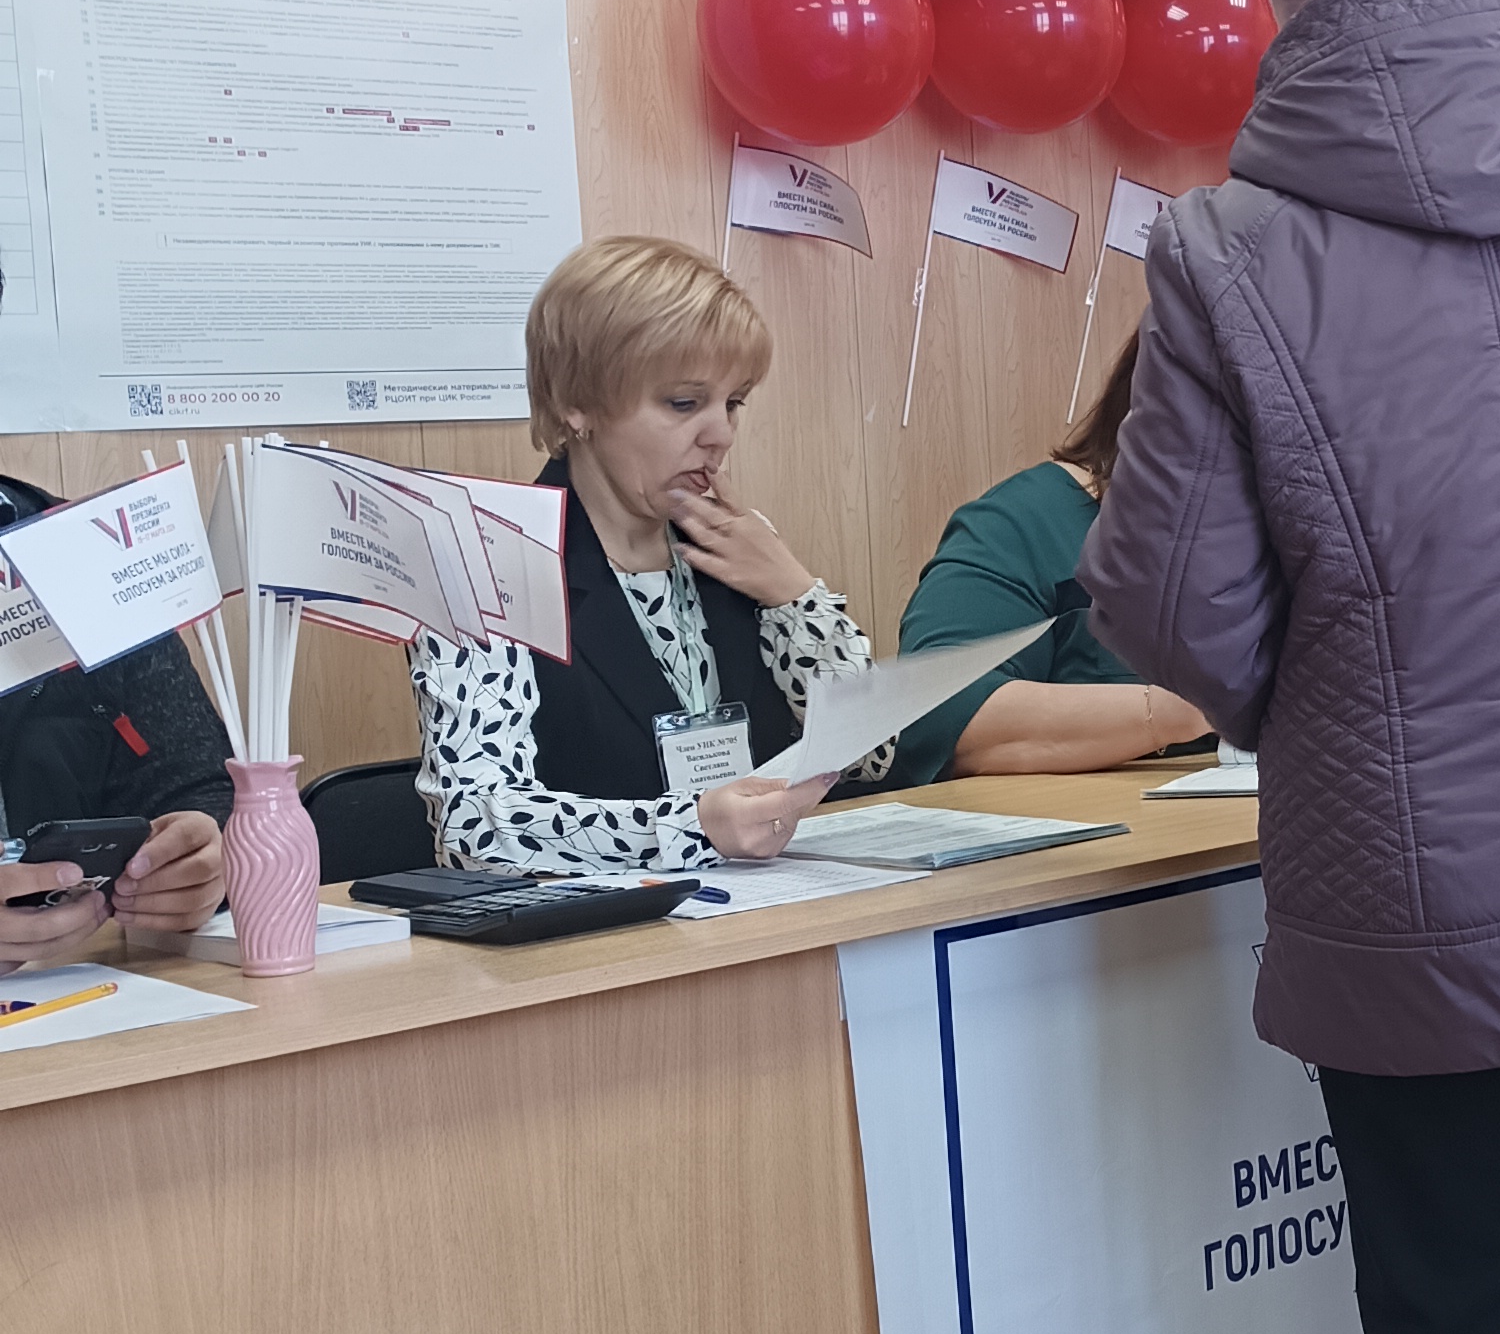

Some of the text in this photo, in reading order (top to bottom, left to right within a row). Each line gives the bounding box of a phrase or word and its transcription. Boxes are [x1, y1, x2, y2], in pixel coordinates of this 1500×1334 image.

[777, 191, 805, 203] ВМЕСТЕ
[806, 196, 818, 205] МЫ
[769, 200, 807, 213] ГОЛОСУЕМ
[808, 206, 817, 216] ЗА
[963, 212, 997, 228] ГОЛОСУЕМ
[971, 205, 997, 219] ВМЕСТЕ
[1010, 218, 1028, 230] СИЛА
[384, 384, 448, 393] Методические
[451, 384, 499, 392] материалы
[167, 391, 281, 404] 8 800 200 00 20
[385, 394, 416, 404] РЦОИТ
[419, 395, 436, 404] при
[439, 394, 458, 403] ЦИК
[128, 494, 158, 512] ВЫБОРЫ
[131, 501, 171, 523] ПРЕЗИДЕНТА
[134, 517, 160, 534] РОССИИ
[330, 527, 366, 549] ВМЕСТЕ
[366, 539, 381, 555] МЫ
[111, 558, 154, 584] ВМЕСТЕ
[151, 550, 171, 568] МЫ
[169, 542, 191, 560] СИЛА
[321, 542, 373, 567] ГОЛОСУЕМ
[373, 557, 384, 571] ЗА
[112, 574, 167, 605] ГОЛОСУЕМ
[165, 569, 178, 583] ЗА
[676, 744, 695, 753] Член
[697, 740, 715, 749] УИК
[693, 761, 729, 772] Светлана
[689, 770, 737, 784] Анатольевна
